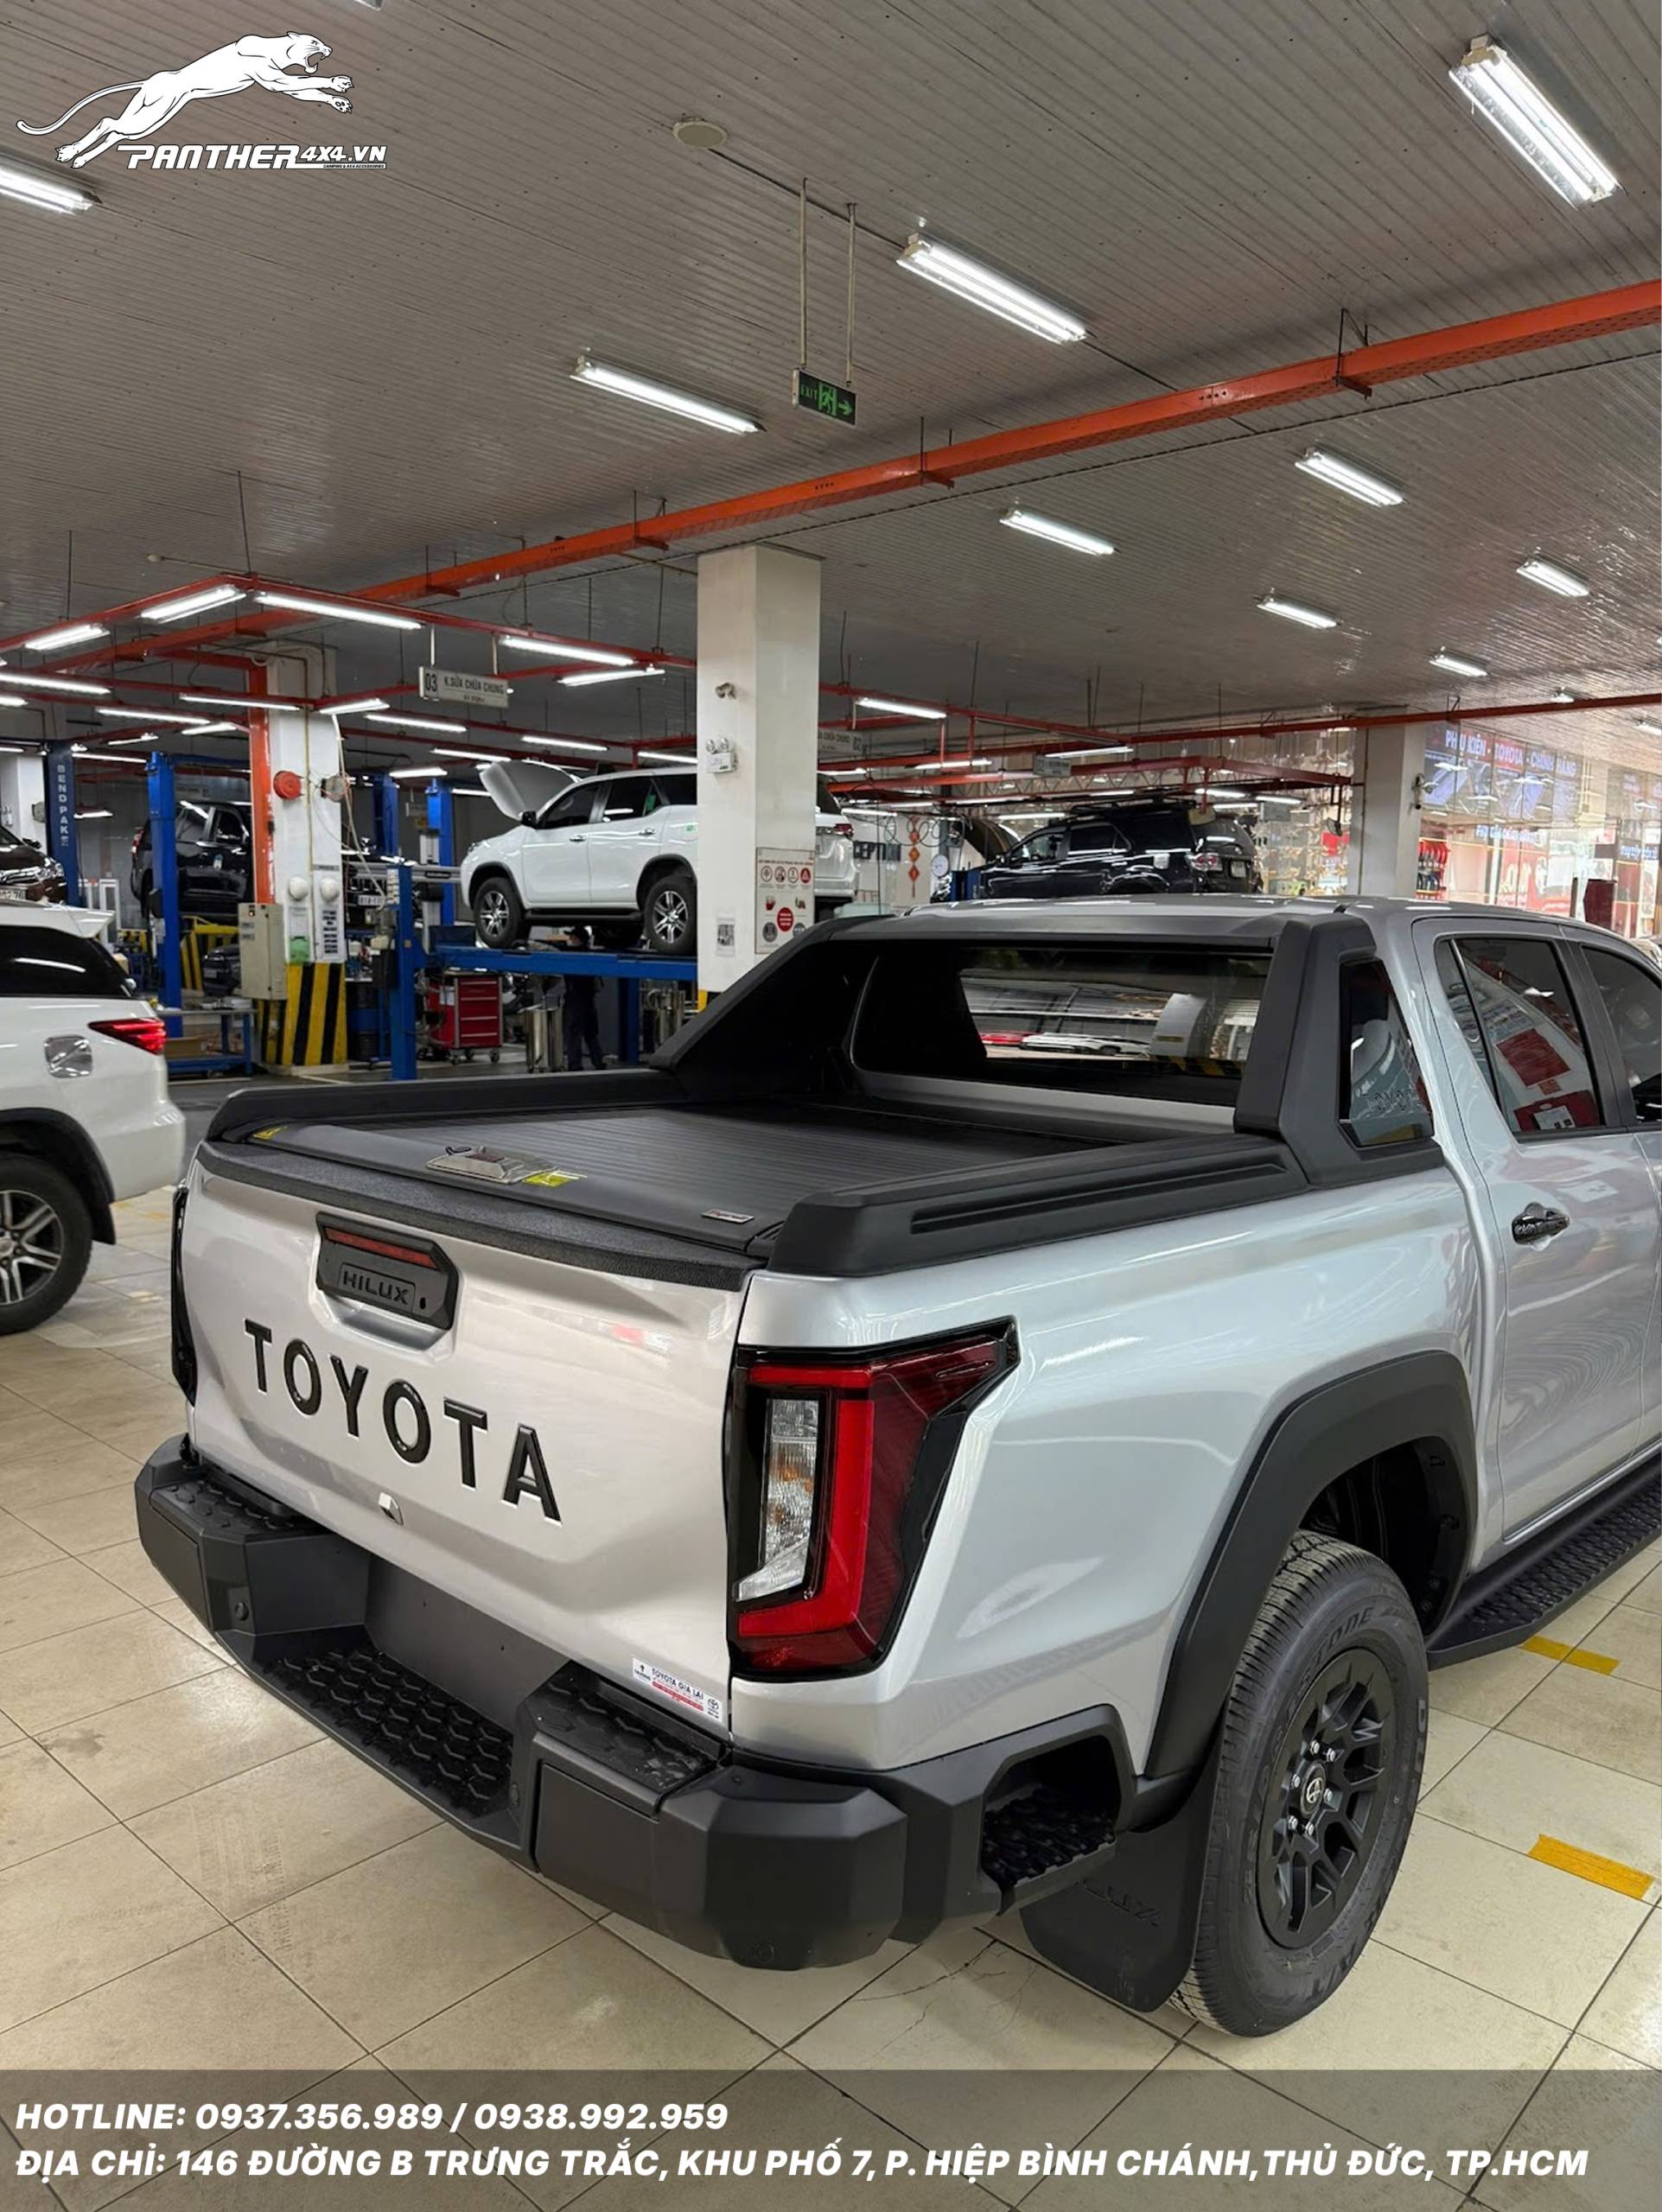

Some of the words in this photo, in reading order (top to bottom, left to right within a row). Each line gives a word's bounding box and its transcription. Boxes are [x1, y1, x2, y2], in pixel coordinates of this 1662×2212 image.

[424, 673, 437, 692] 03
[1494, 742, 1523, 766] TOYOTA
[343, 1270, 409, 1306] HILUX
[244, 1319, 563, 1525] TOYOTA
